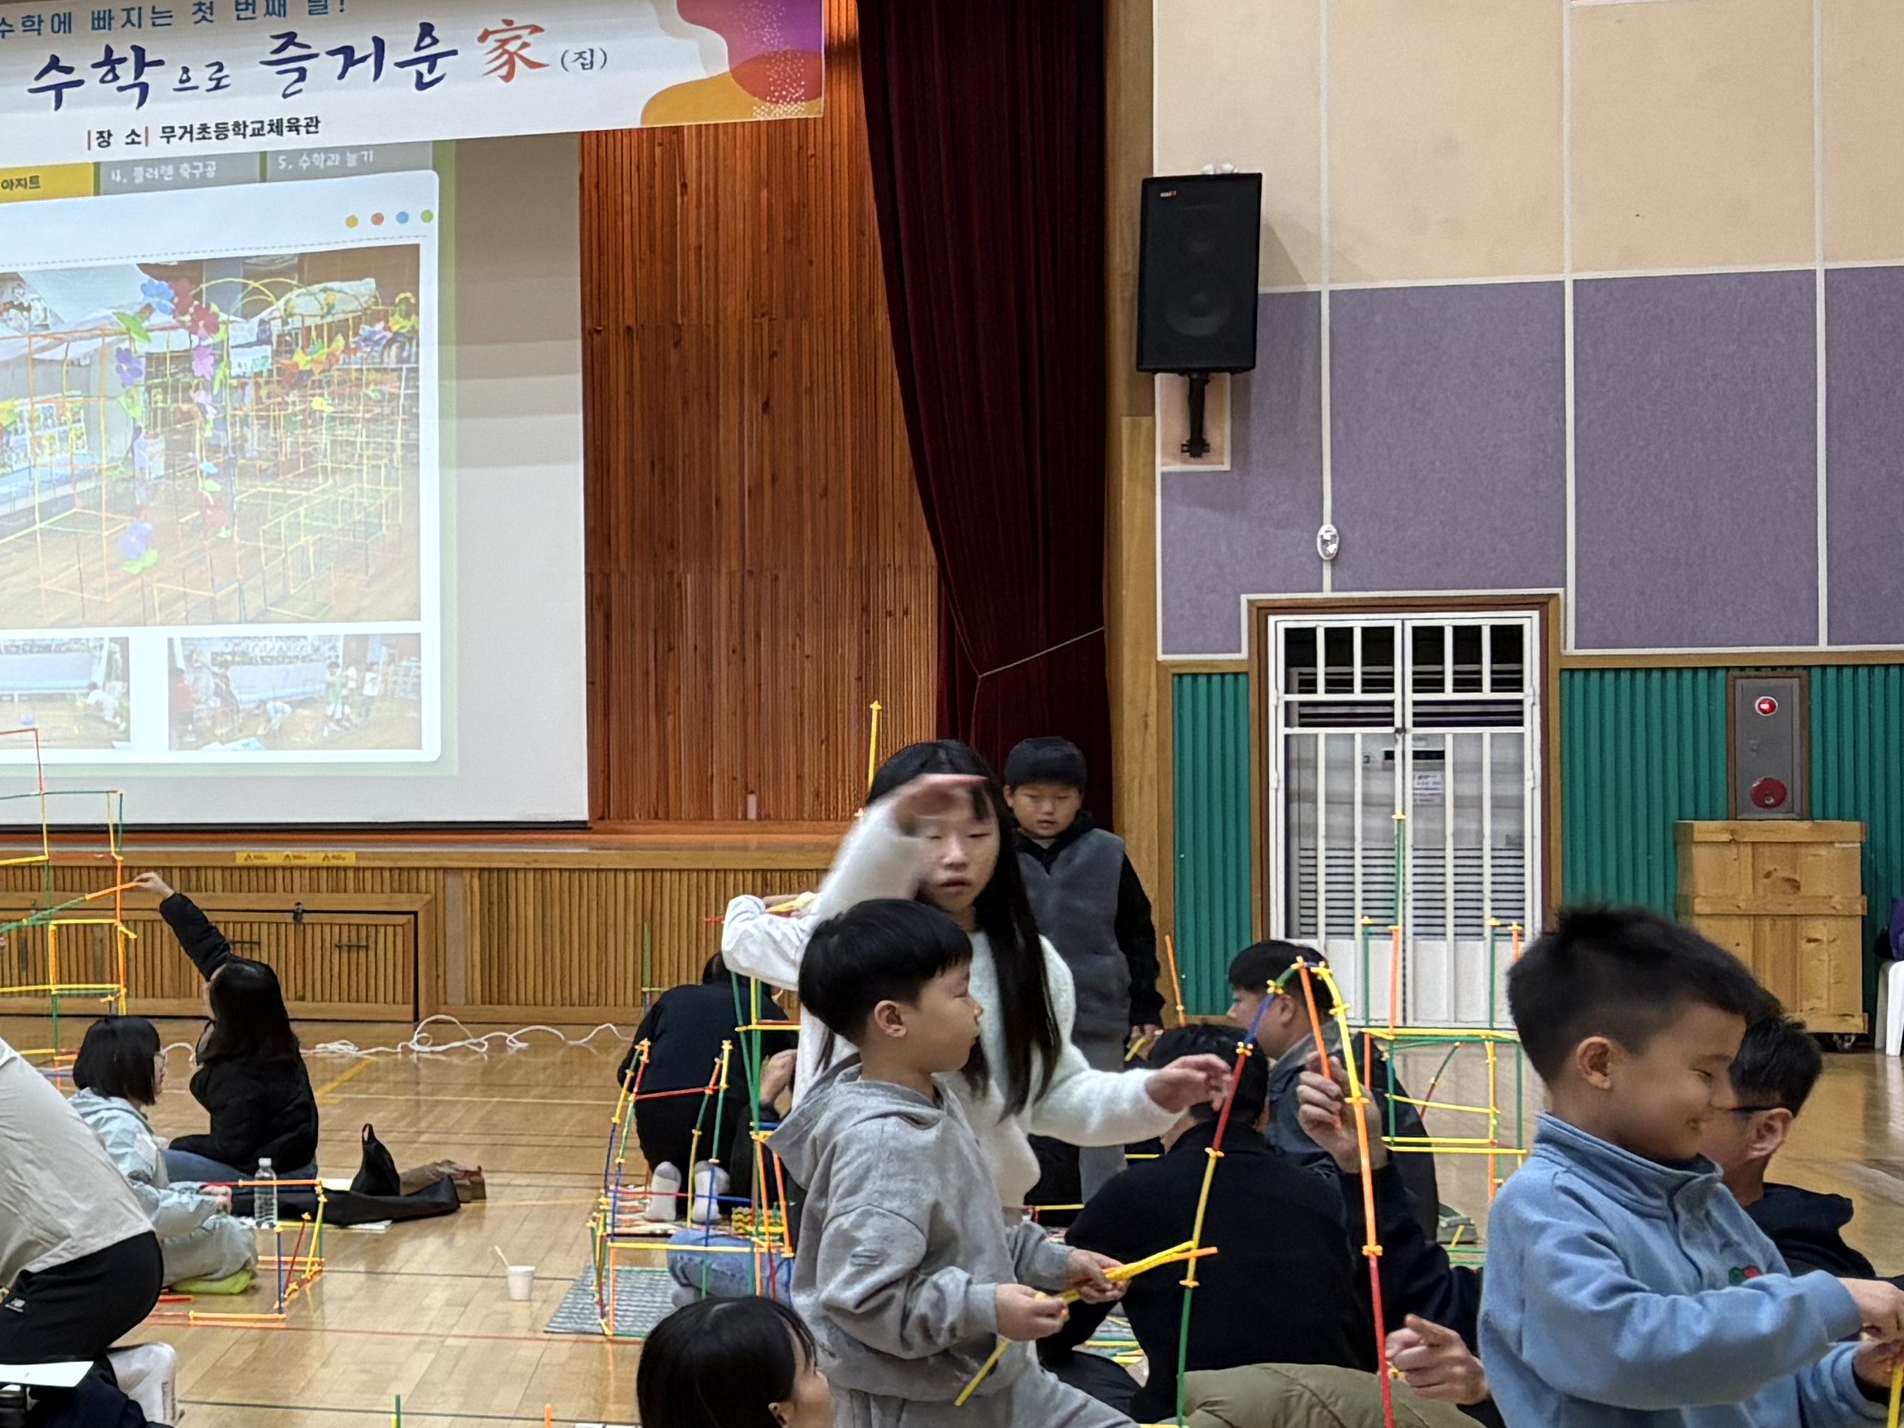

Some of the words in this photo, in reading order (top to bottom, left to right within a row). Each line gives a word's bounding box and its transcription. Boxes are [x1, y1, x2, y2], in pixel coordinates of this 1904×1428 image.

[90, 2, 175, 33] 빠지는
[259, 21, 460, 101] 즐거운
[158, 115, 322, 146] 무거초등학교체육관
[277, 155, 293, 171] 5.
[297, 152, 341, 171] 수학과
[0, 174, 42, 192] 아지트
